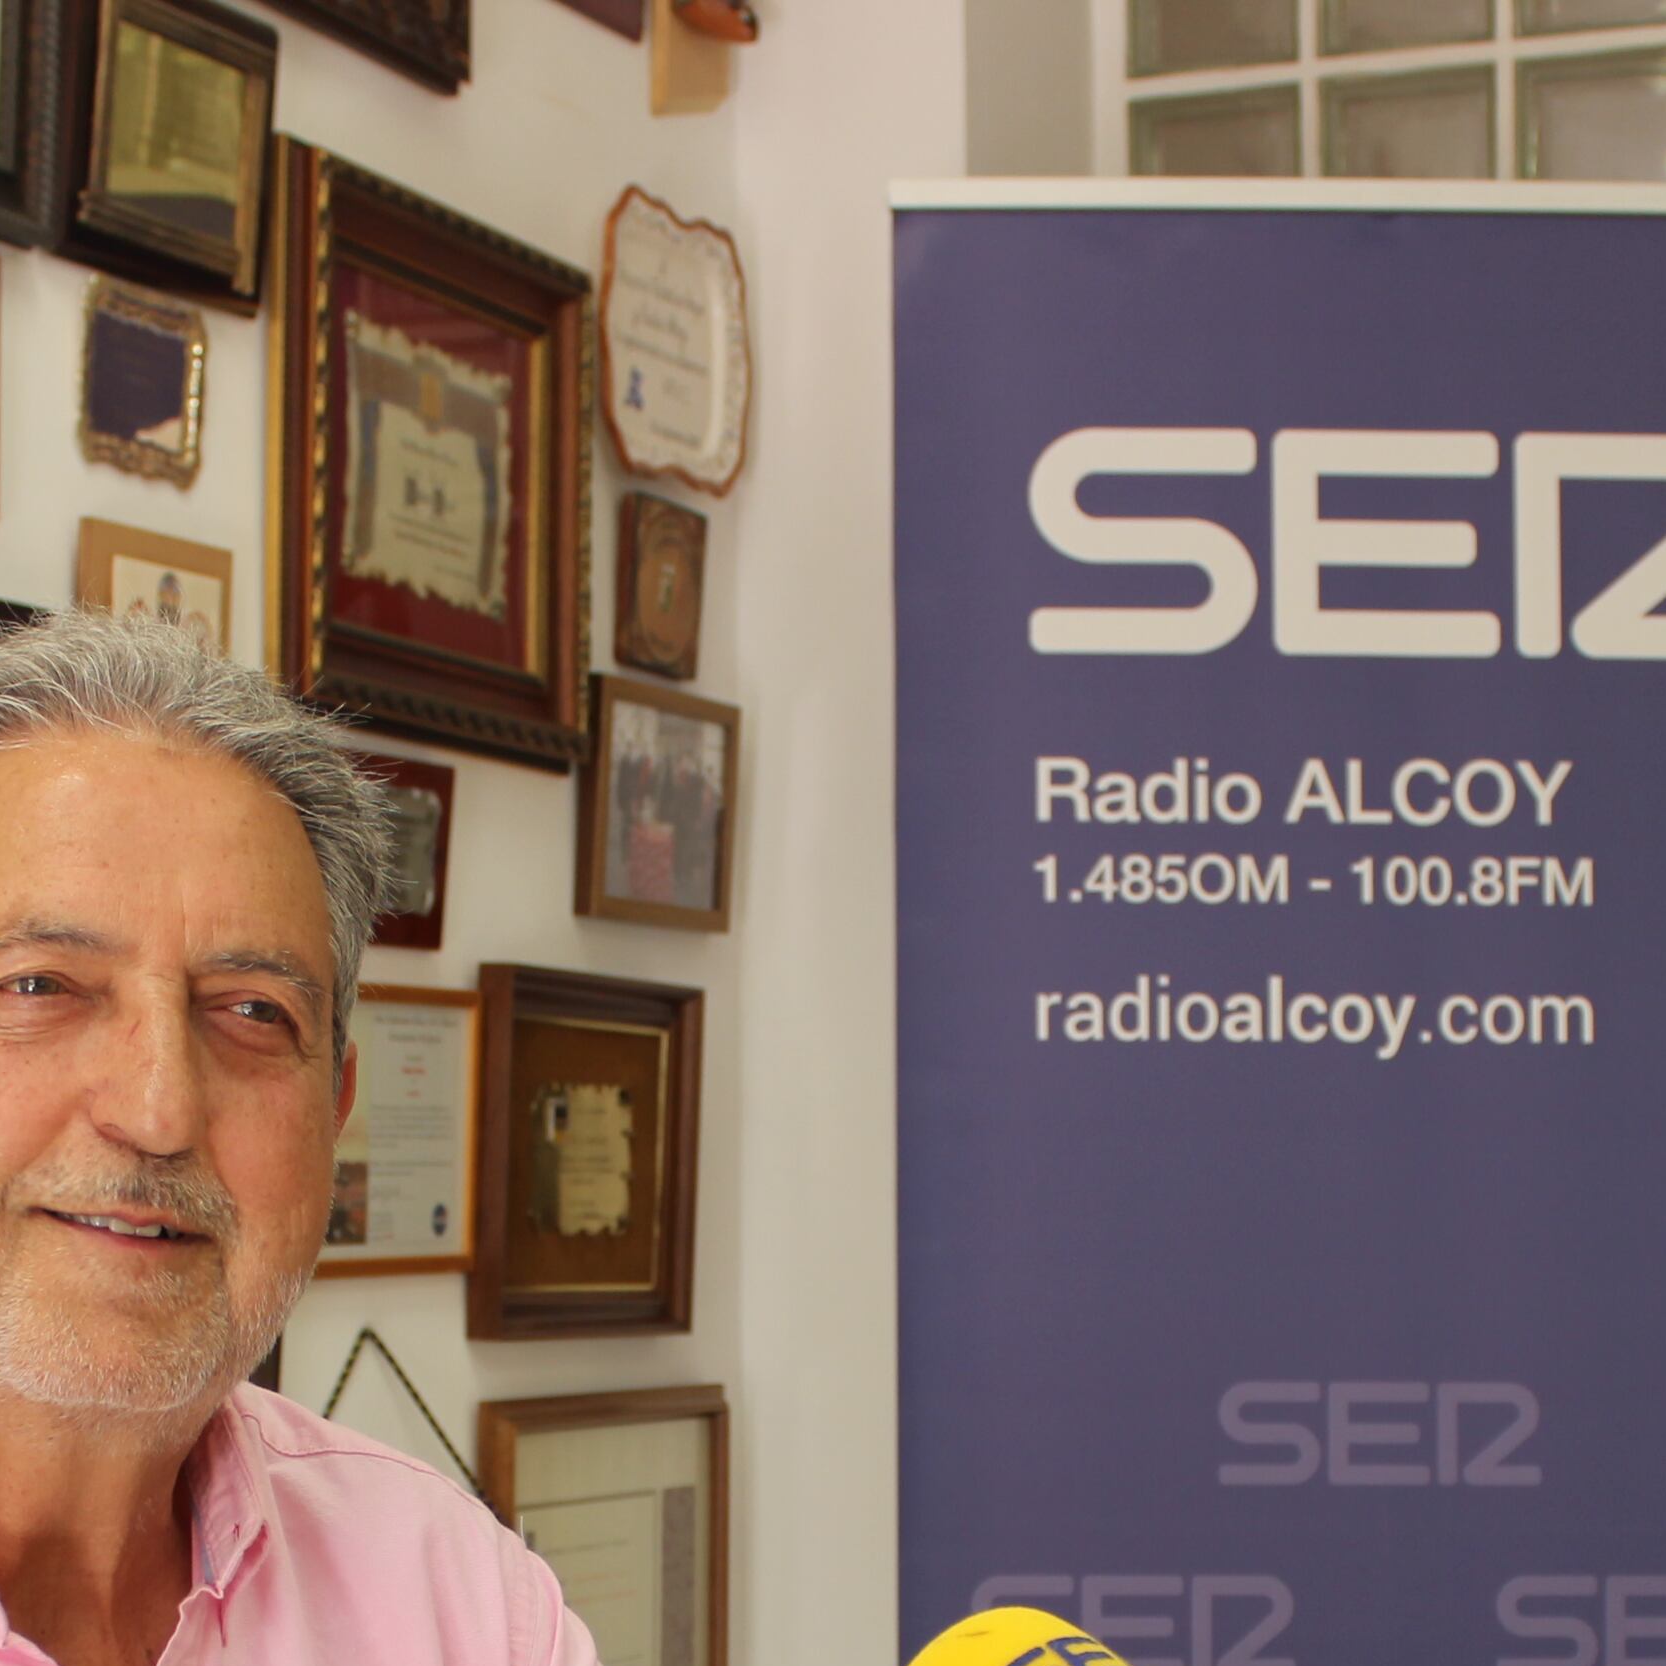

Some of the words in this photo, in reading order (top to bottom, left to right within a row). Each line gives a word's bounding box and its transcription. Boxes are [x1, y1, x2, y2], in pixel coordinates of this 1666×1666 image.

[1034, 756, 1261, 823] Radio
[1284, 758, 1572, 826] ALCOY
[1350, 857, 1595, 906] 100.8FM
[1034, 975, 1595, 1060] radioalcoy.com
[1218, 1382, 1542, 1486] SER
